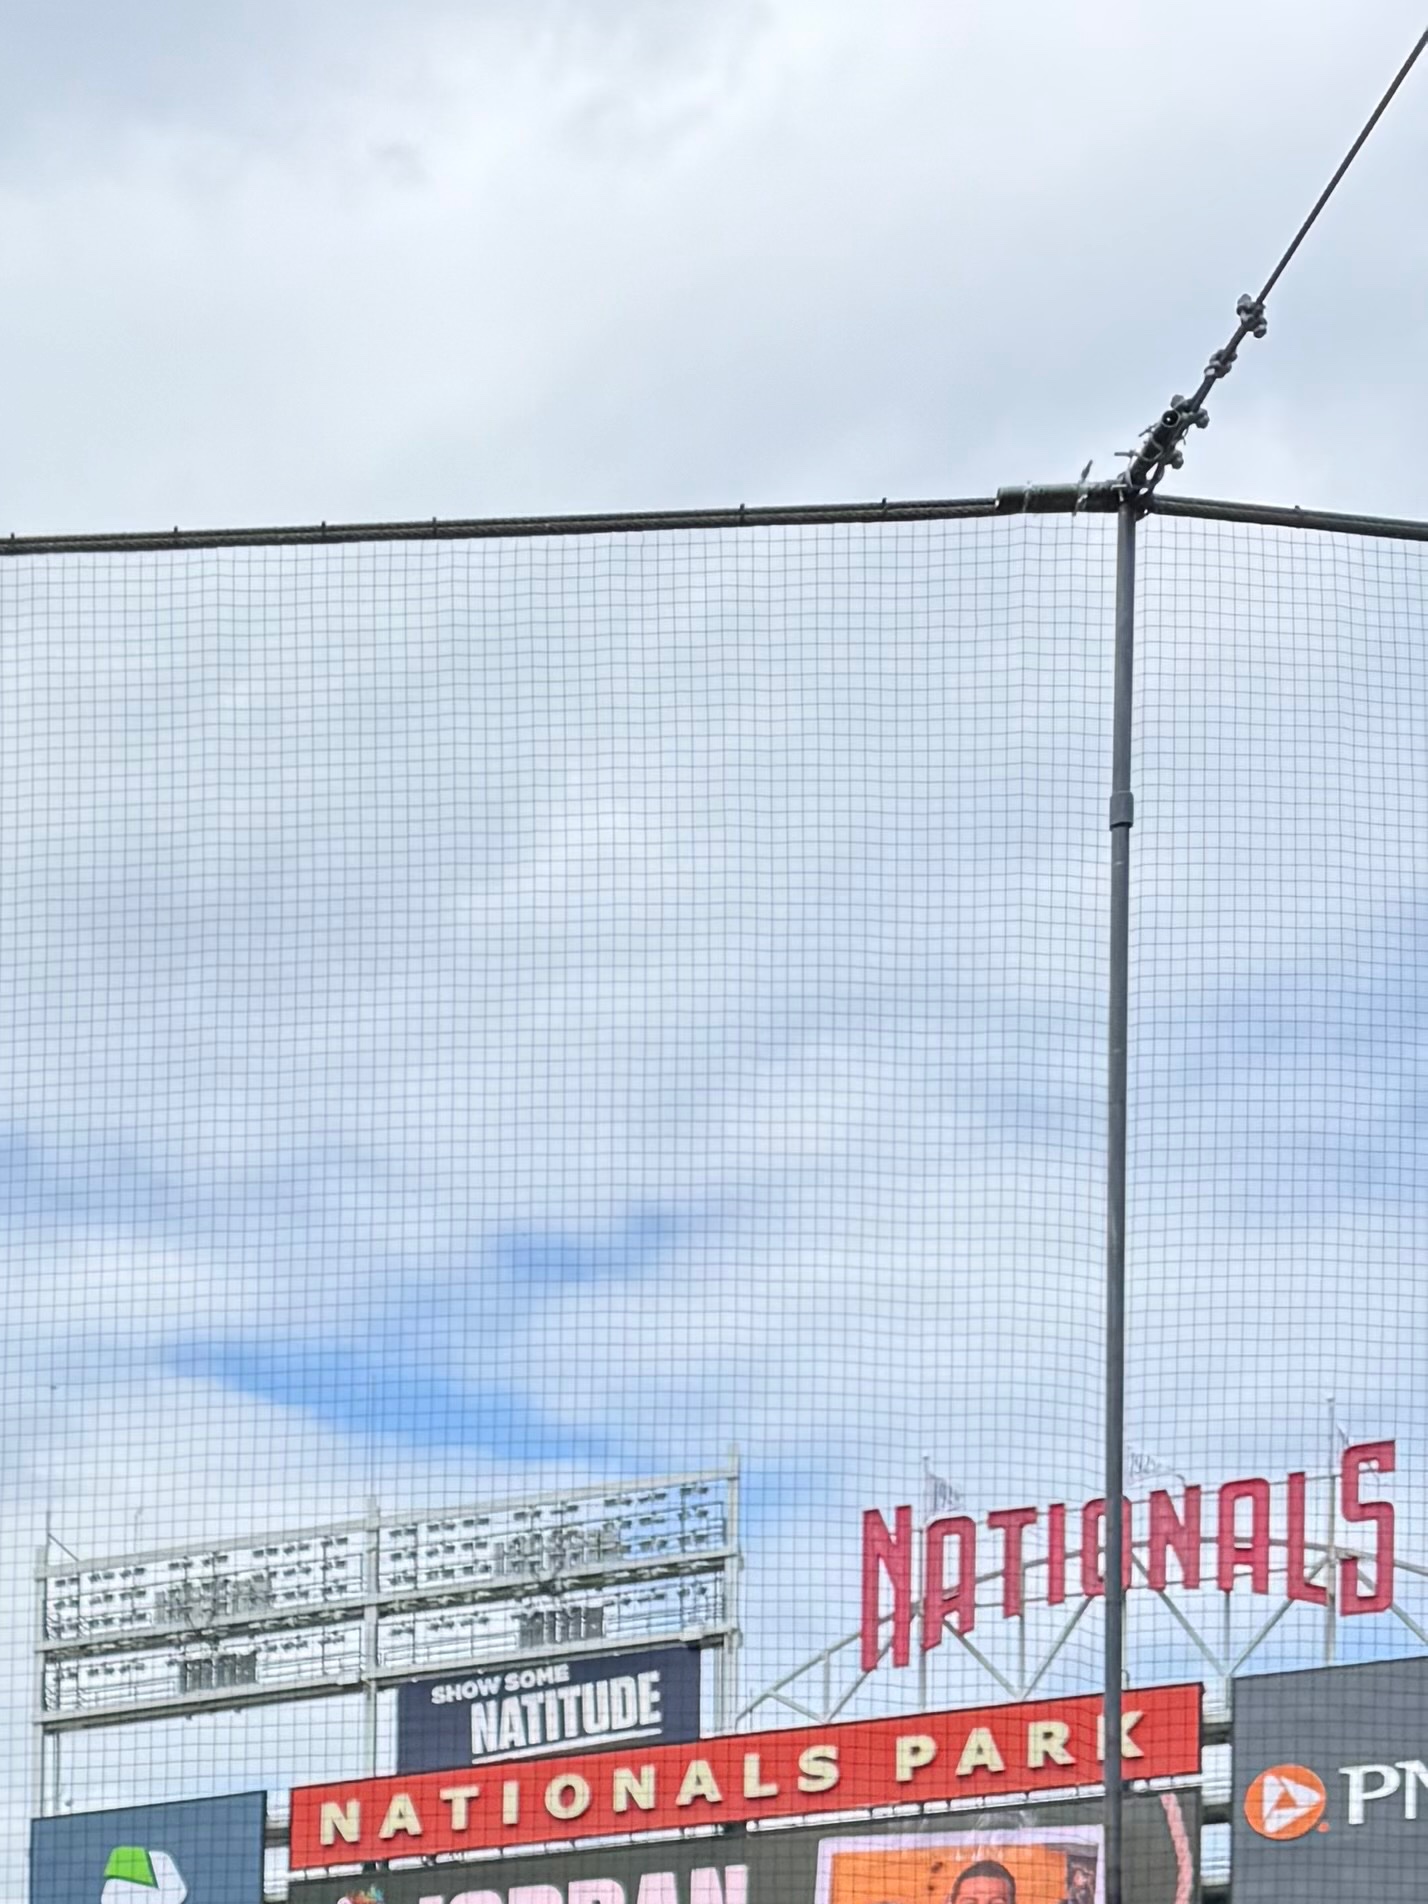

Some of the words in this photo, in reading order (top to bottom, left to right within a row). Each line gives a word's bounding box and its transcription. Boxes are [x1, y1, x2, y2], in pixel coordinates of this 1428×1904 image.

[861, 1440, 1396, 1673] NATIONALS
[431, 1676, 502, 1704] SHOW
[504, 1664, 570, 1691] SOME
[470, 1669, 662, 1756] NATITUDE
[319, 1743, 841, 1847] NATIONALS
[896, 1711, 1145, 1784] PARK
